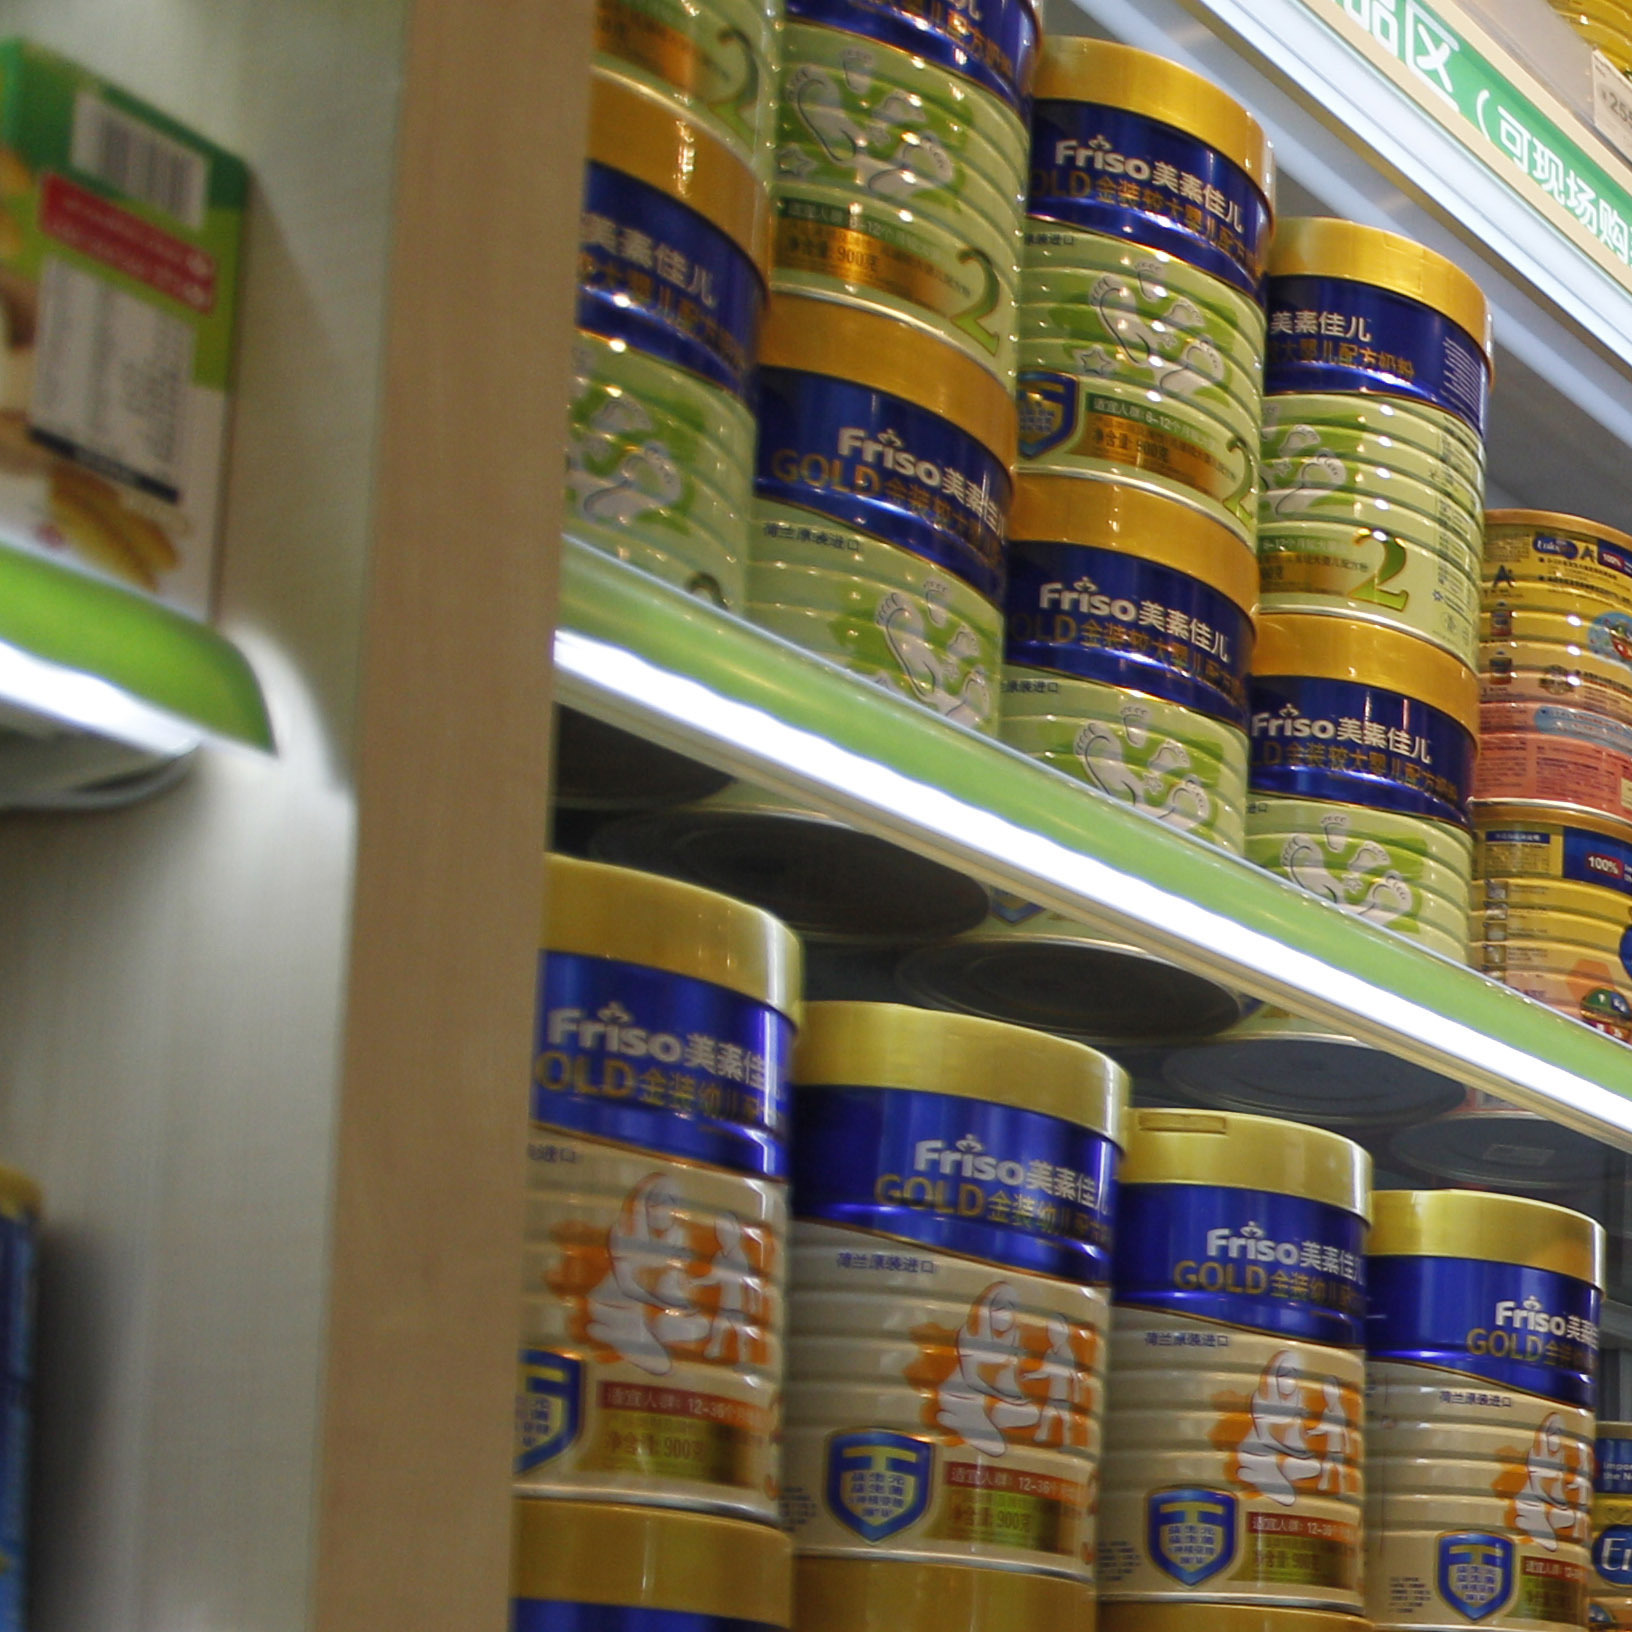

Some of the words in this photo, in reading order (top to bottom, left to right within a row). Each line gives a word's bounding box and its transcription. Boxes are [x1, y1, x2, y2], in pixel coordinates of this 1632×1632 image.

[1055, 139, 1151, 180] Friso
[839, 427, 940, 487] Friso
[1039, 582, 1137, 622] Friso
[1252, 710, 1335, 741] Friso
[1337, 717, 1432, 764] 美素佳儿
[1588, 854, 1619, 875] 100%
[547, 1007, 680, 1062] Friso
[914, 1139, 1025, 1186] Friso
[1206, 1228, 1298, 1265] Friso
[1495, 1301, 1565, 1337] Friso
